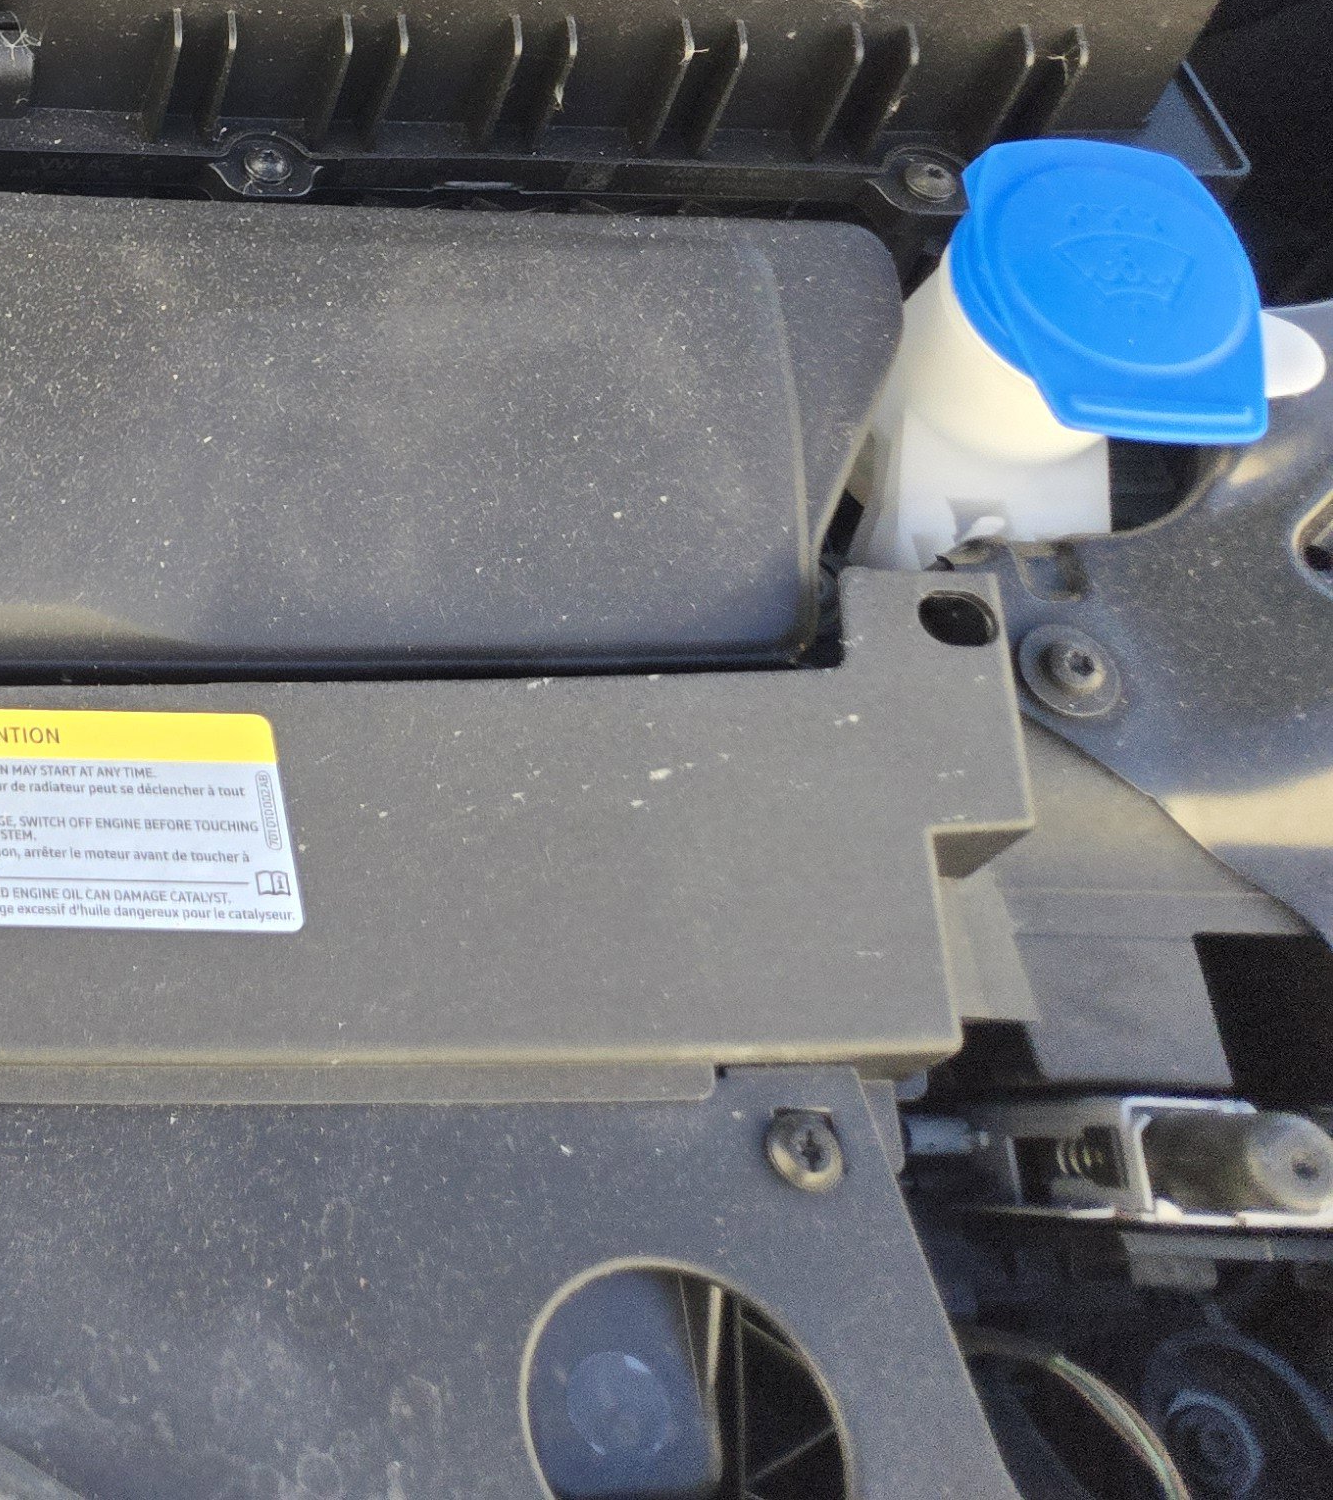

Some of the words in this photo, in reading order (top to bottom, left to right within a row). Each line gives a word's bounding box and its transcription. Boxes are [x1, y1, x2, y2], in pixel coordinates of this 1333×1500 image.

[12, 765, 36, 776] MAY
[40, 765, 76, 776] START
[80, 766, 93, 777] AT
[97, 766, 120, 777] ANY
[19, 816, 65, 827] SWITCH
[69, 817, 93, 828] OFF
[96, 818, 141, 829] ENGINE
[144, 819, 192, 831] BEFORE
[195, 820, 258, 832] TOUCHING
[13, 887, 59, 899] ENGINE
[62, 888, 83, 899] OIL
[85, 889, 110, 900] CAN
[114, 890, 167, 902] DAMAGE
[170, 891, 232, 904] CATALYST.
[17, 903, 65, 915] excessif
[69, 903, 111, 916] d'huile
[114, 906, 178, 920] dangereux
[183, 907, 210, 920] pour
[214, 907, 225, 919] le
[228, 909, 295, 923] catalyseur.
